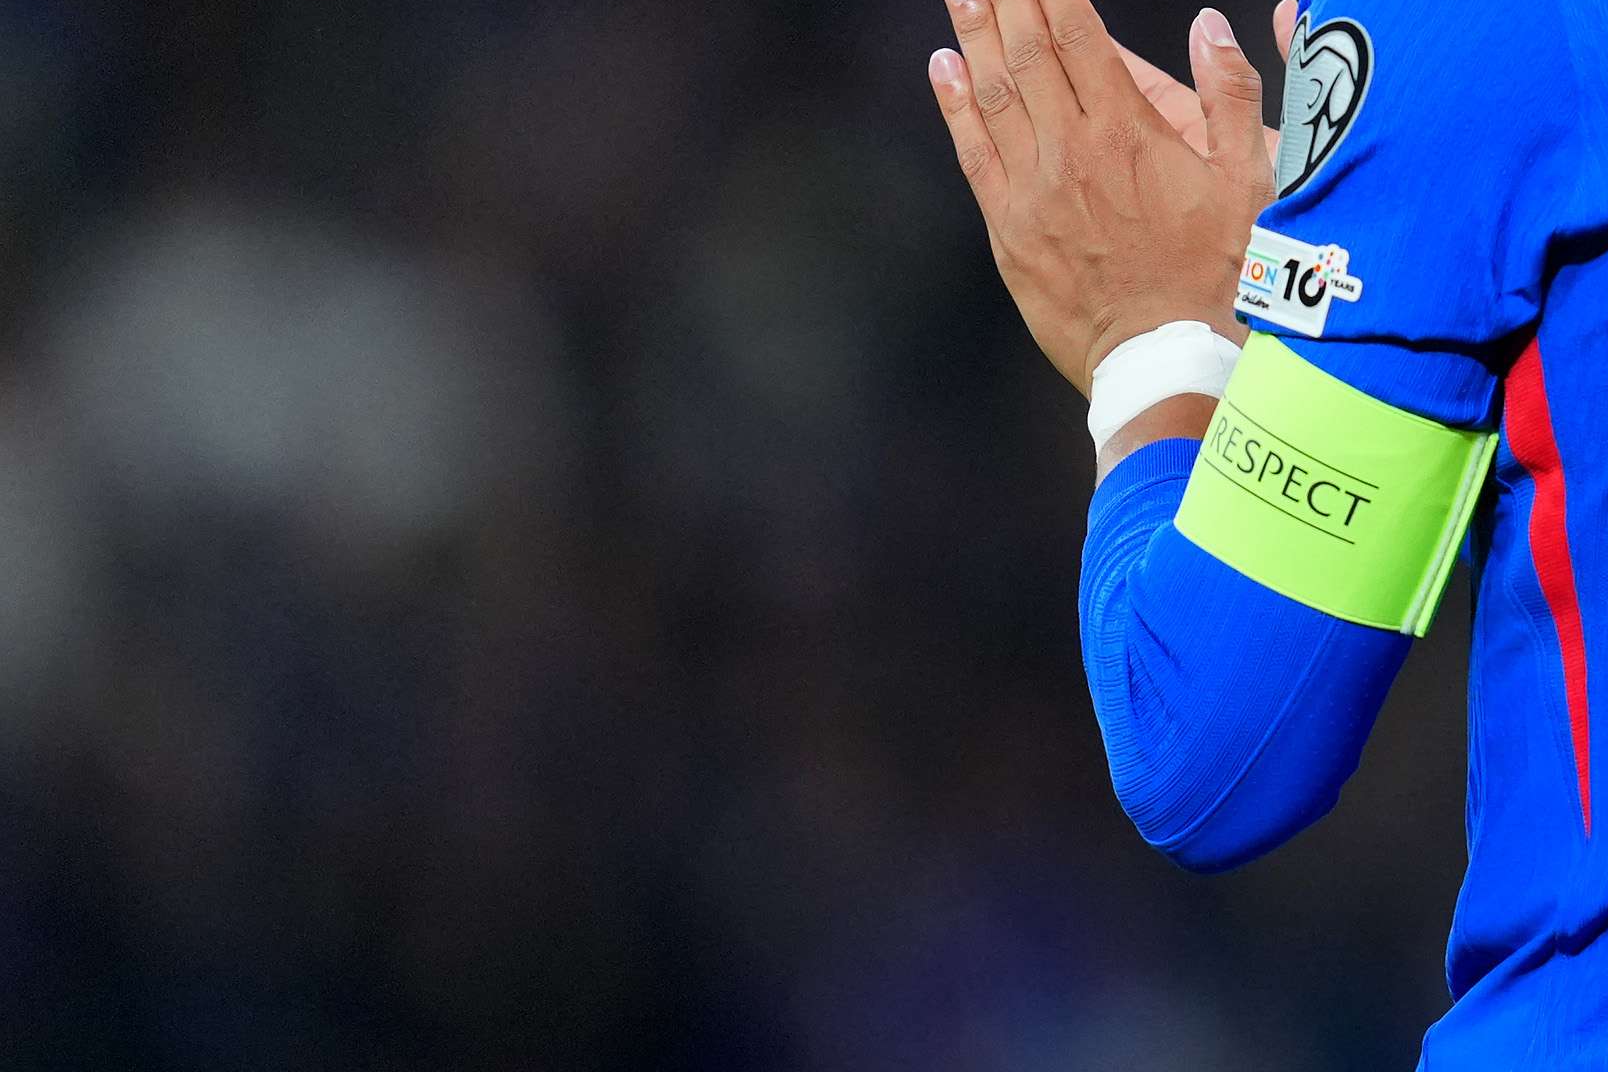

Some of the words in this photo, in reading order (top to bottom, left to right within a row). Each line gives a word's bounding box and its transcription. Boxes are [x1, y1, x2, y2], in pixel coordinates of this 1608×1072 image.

[1243, 258, 1278, 286] ION
[1283, 258, 1327, 308] 10
[1210, 416, 1372, 527] RESPECT
